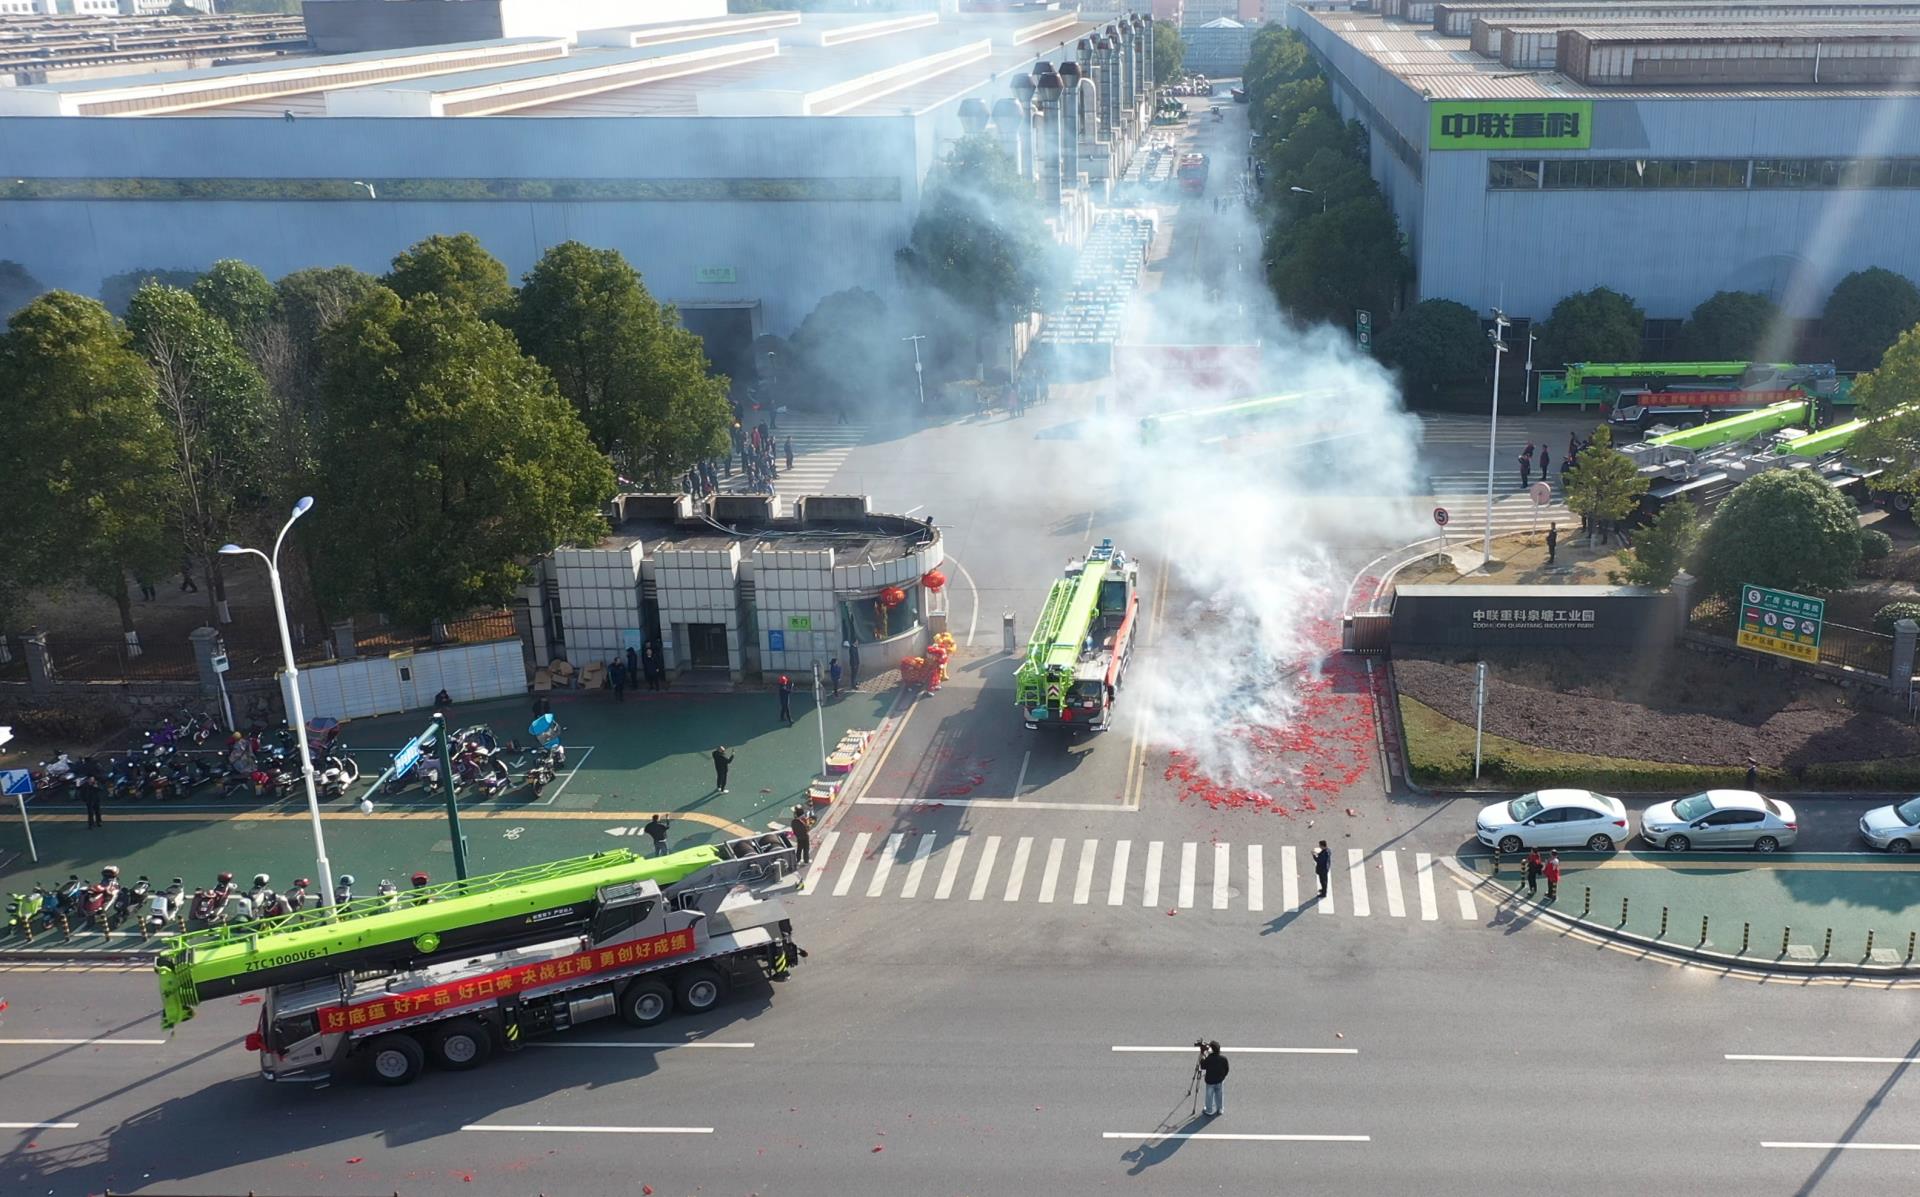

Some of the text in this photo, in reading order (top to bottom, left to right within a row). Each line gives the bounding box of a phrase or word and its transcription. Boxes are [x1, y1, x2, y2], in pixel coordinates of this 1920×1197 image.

[1441, 113, 1579, 138] 中联重科
[1438, 511, 1445, 521] 5
[1472, 609, 1595, 622] 中联重科泉塘工业园
[245, 947, 328, 971] ZTC1000V6-1
[328, 934, 687, 1028] 好底蕴 好产品 好口碑 决战红海 勇创好成绩
